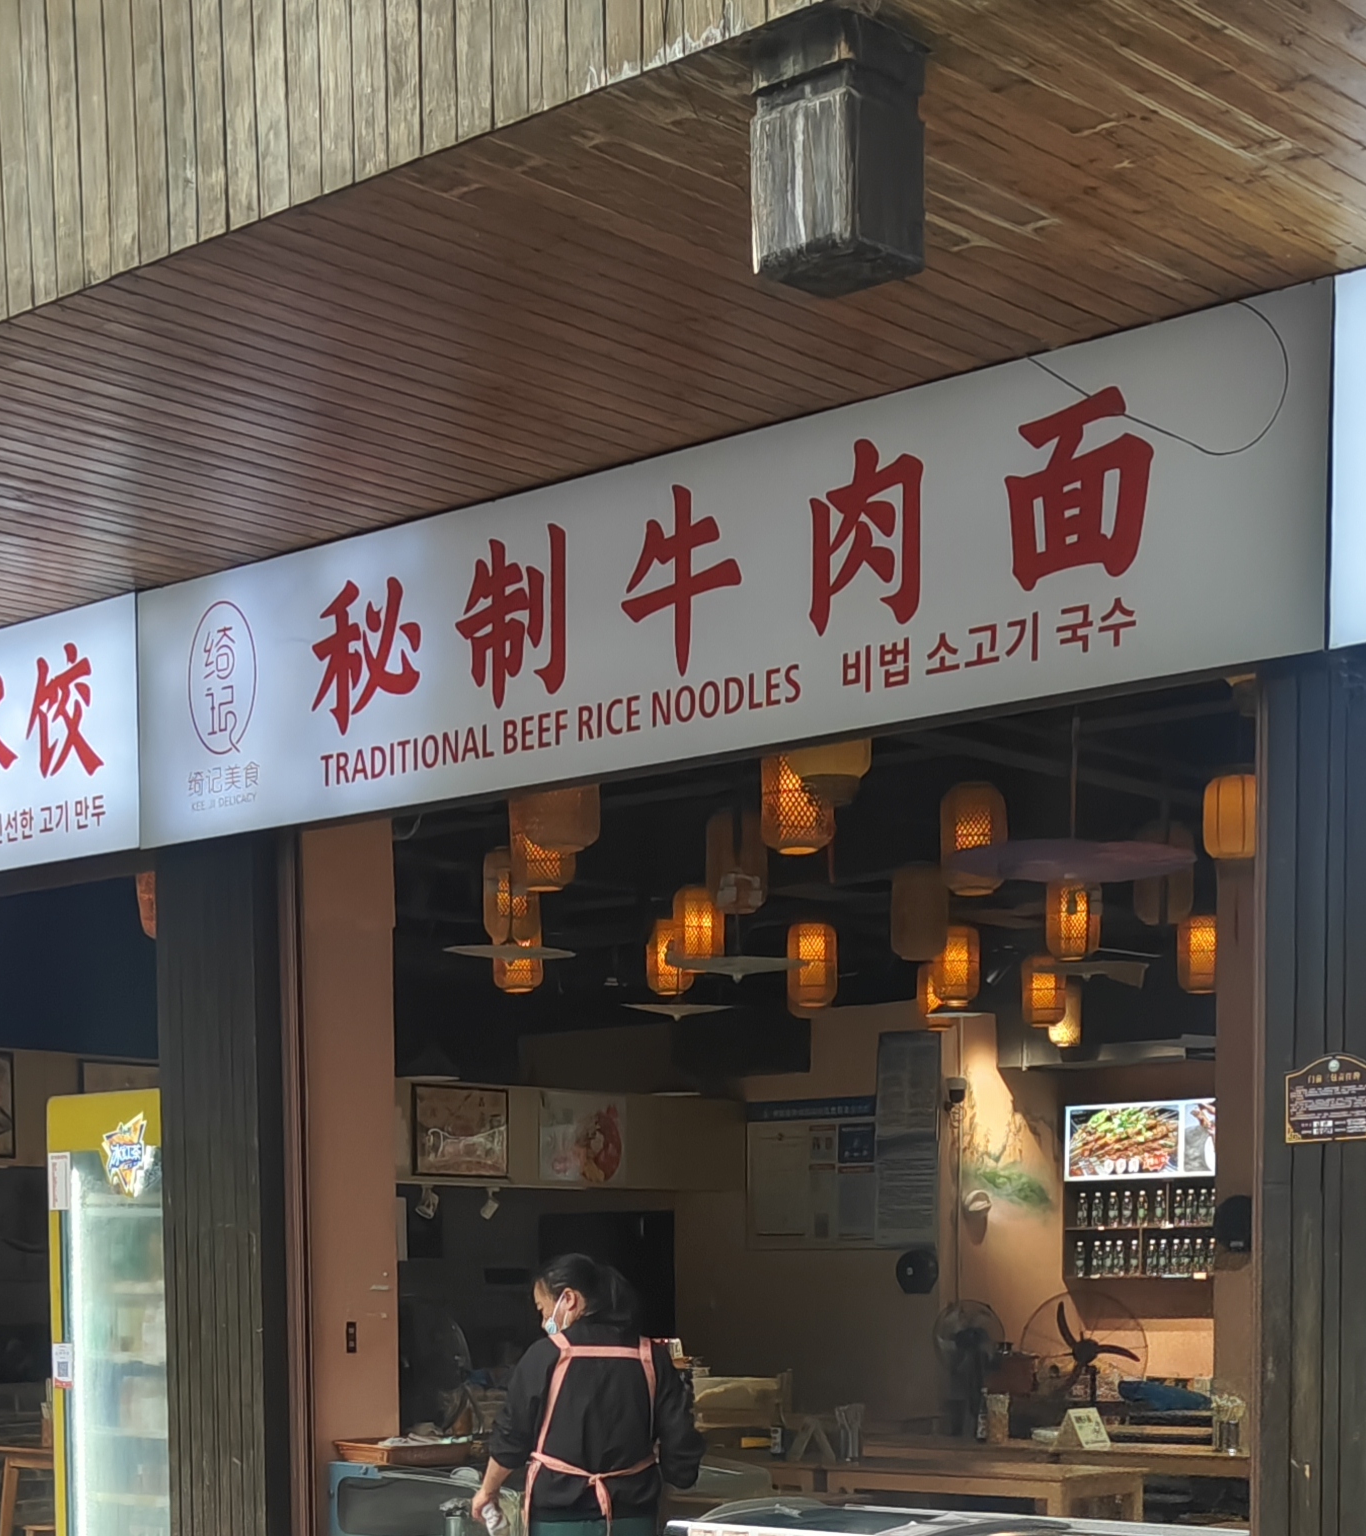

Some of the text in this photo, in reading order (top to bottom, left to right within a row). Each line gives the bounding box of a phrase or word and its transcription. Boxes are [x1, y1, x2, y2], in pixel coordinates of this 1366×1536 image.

[312, 385, 1155, 738] 秘制牛肉面
[842, 597, 1136, 693] 비법 소고기 국수
[320, 664, 801, 787] TRADITIONAL BEEF RICE NOODLES
[39, 800, 69, 834] 고기
[74, 795, 106, 830] 만두
